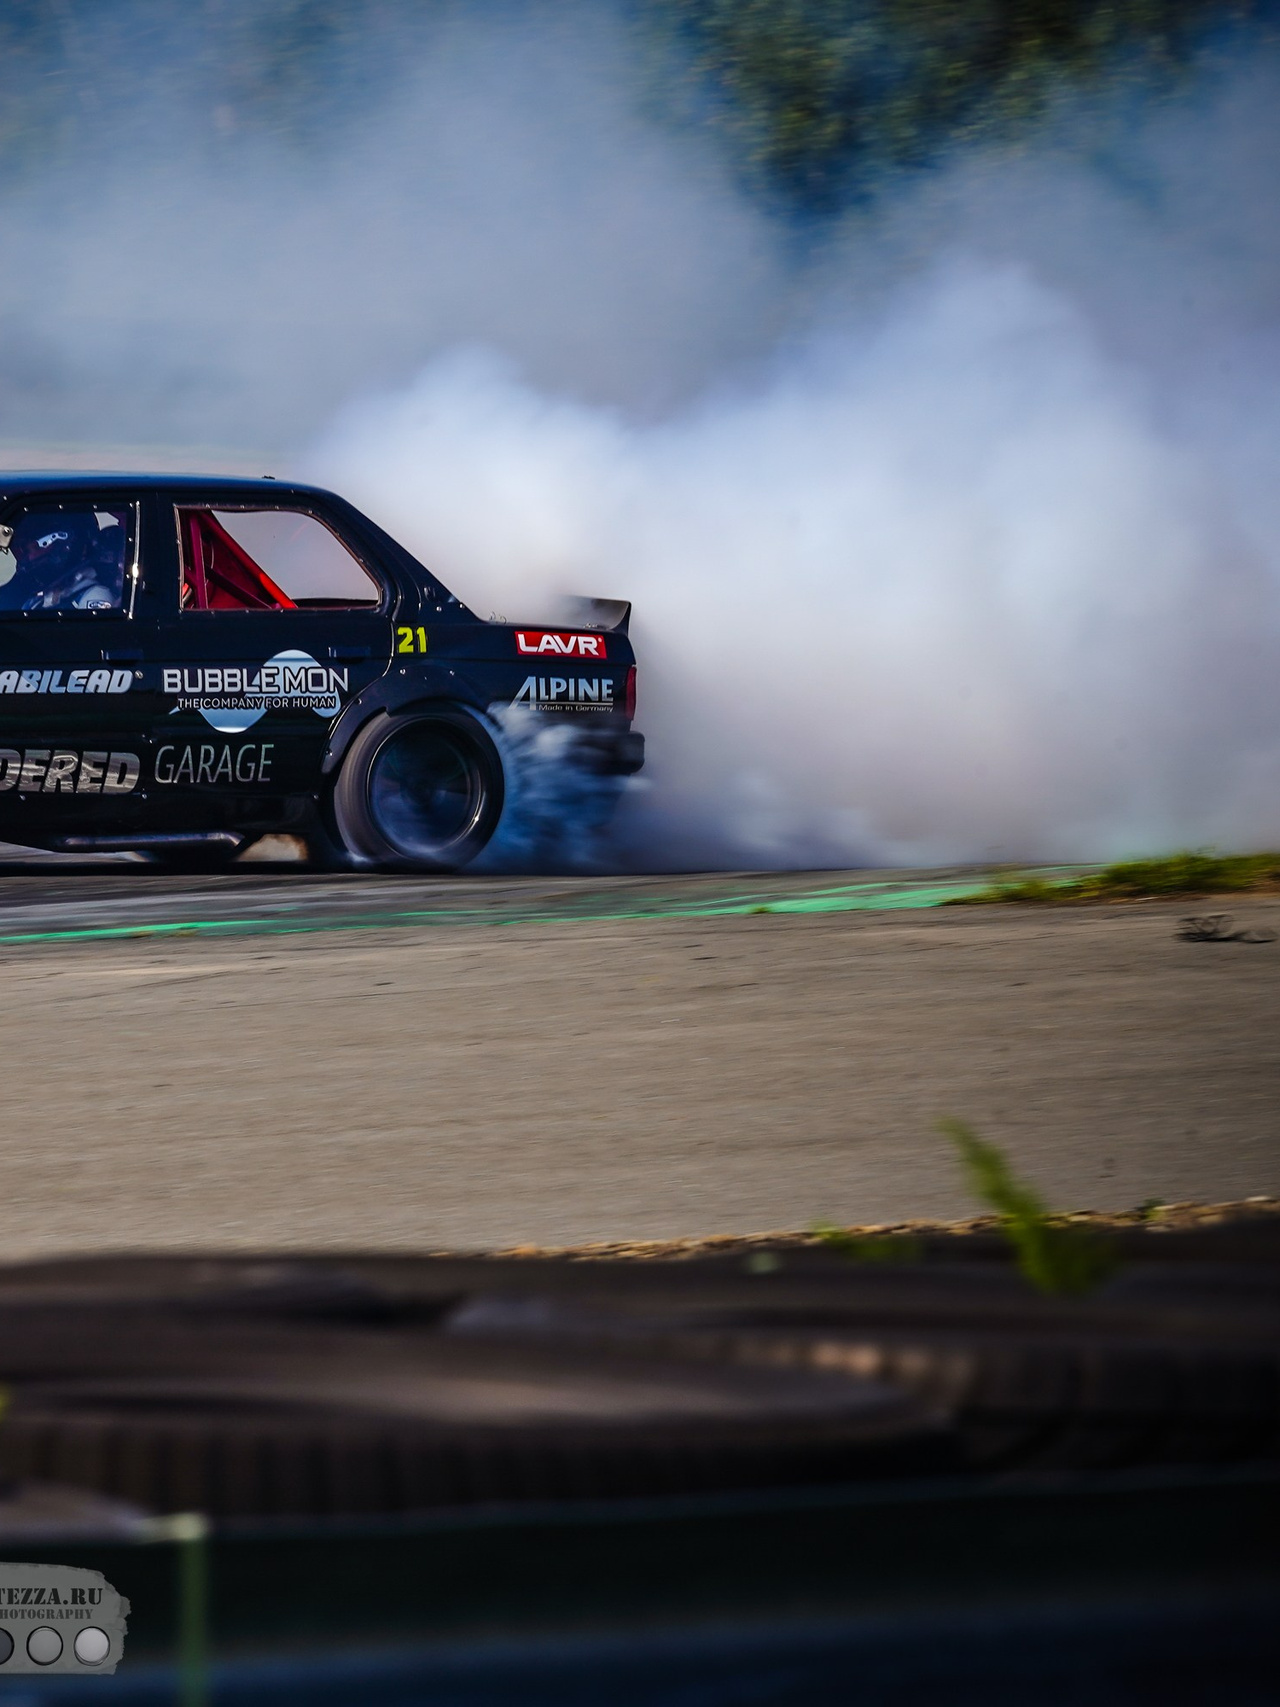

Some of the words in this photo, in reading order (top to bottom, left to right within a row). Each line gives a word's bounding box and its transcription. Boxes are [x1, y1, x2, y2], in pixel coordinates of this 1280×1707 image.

[396, 626, 428, 654] 21
[517, 633, 599, 656] LAVR
[177, 697, 200, 709] THE
[203, 697, 263, 709] COMPANY
[265, 697, 289, 709] FOR
[292, 697, 336, 709] HUMAN
[508, 675, 614, 711] ALPINE
[538, 704, 563, 712] Made
[565, 704, 573, 712] in
[575, 704, 614, 713] Germany
[154, 743, 275, 784] GARAGE
